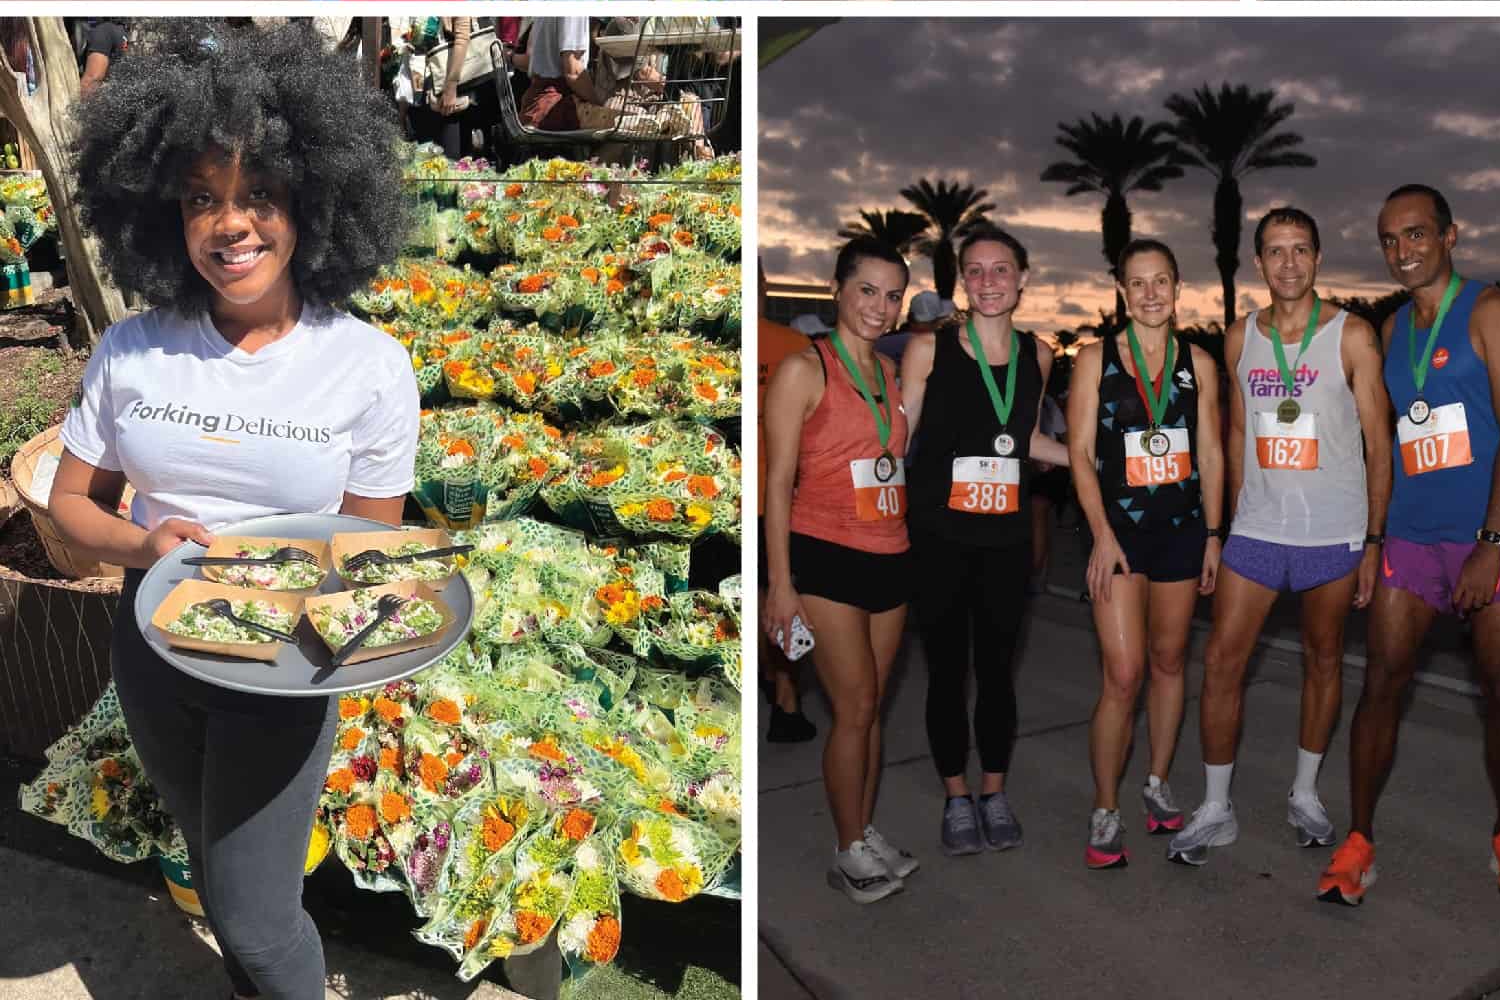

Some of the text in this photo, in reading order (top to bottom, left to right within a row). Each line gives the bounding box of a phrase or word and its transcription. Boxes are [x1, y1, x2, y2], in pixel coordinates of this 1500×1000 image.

[1248, 363, 1320, 387] meldy
[129, 401, 332, 443] Forking Delicious
[1267, 438, 1301, 466] 162
[1413, 433, 1449, 471] 107
[1142, 454, 1180, 482] 195
[877, 487, 900, 516] 40
[963, 483, 1009, 512] 386
